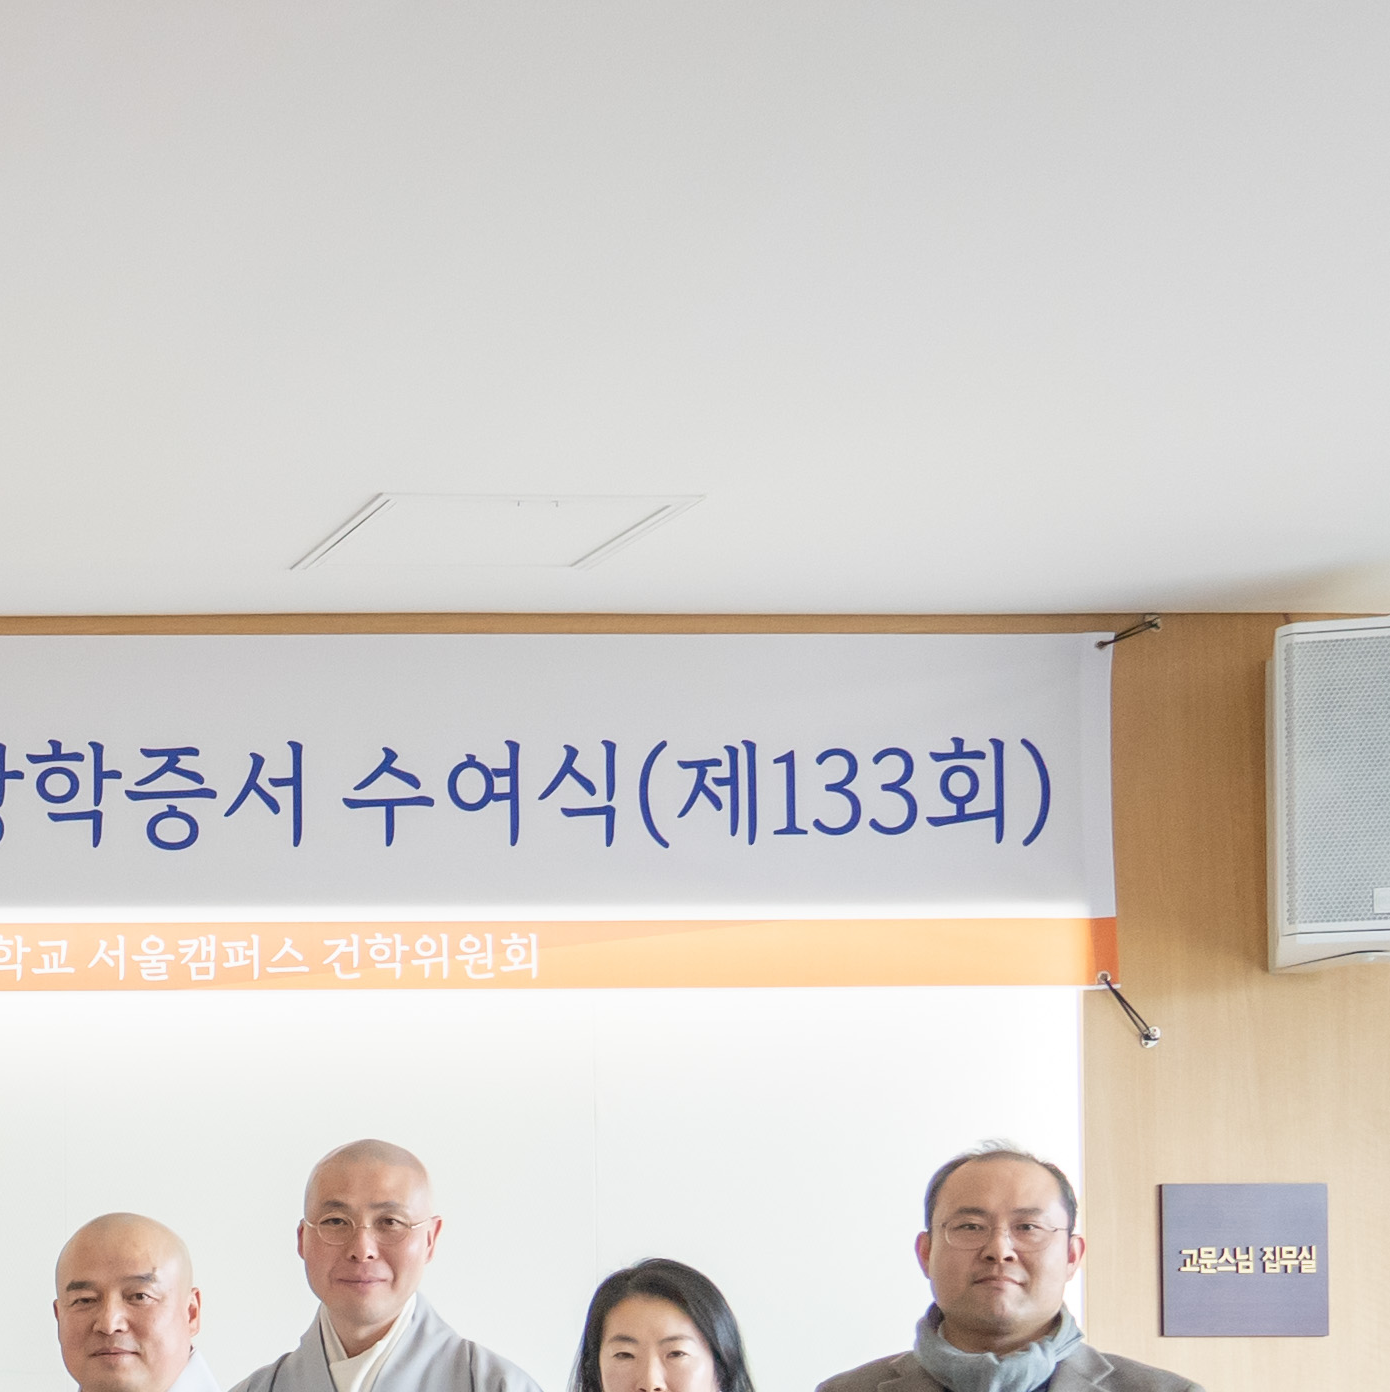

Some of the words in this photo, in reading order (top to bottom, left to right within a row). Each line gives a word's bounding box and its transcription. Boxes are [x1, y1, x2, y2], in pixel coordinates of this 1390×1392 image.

[341, 735, 1051, 850] 수여식(제133회)
[87, 934, 311, 981] 서울캠퍼스
[322, 931, 539, 980] 건학위원회
[1179, 1246, 1255, 1274] 고문스님
[1262, 1245, 1317, 1274] 집무실
